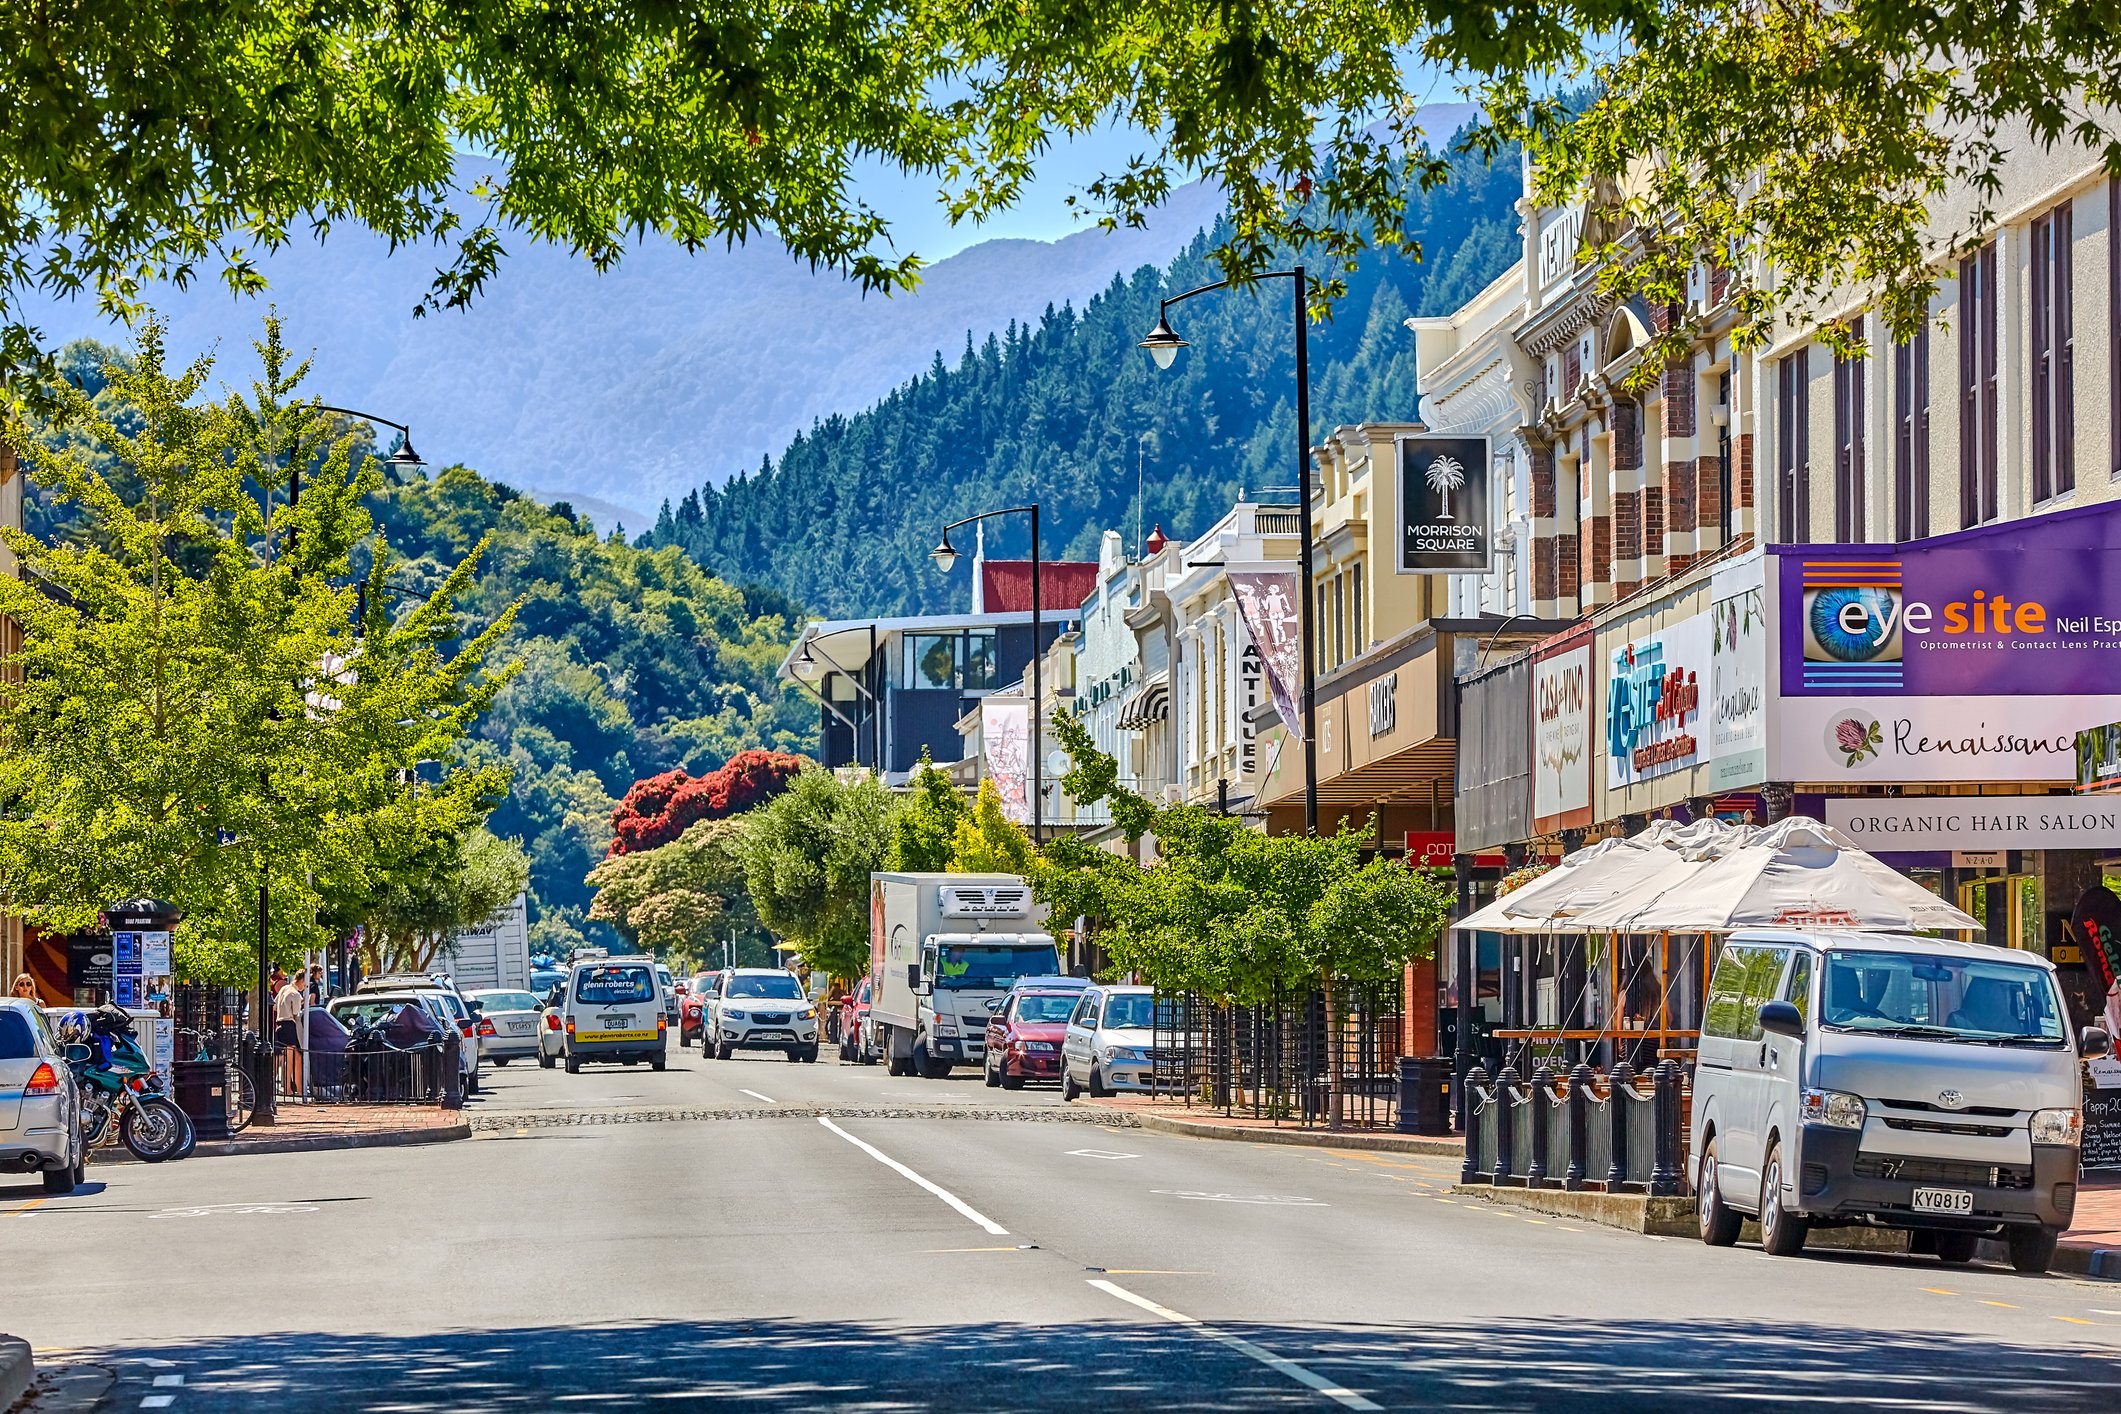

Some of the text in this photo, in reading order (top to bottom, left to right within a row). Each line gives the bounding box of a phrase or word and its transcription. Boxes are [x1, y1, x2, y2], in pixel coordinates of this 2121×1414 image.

[1407, 525, 1482, 536] MORRISON
[1416, 539, 1475, 551] SQUARE
[1839, 602, 1933, 647] eye
[1943, 589, 2046, 634] site
[2056, 617, 2089, 633] Neil
[1920, 640, 1992, 651] Optometrist
[1997, 640, 2004, 649] &
[2011, 640, 2057, 649] Contact
[2062, 640, 2088, 649] Lens
[1540, 673, 1559, 723] CASA
[1563, 664, 1584, 714] VINO
[1715, 666, 1760, 725] Renaissance
[1894, 718, 2077, 756] Renaissanc
[1850, 814, 2116, 833] ORGANIC HAIR SALON
[1785, 915, 1848, 926] STELLA
[2083, 917, 2114, 987] Roma
[583, 980, 635, 990] glenn roberts
[1914, 1191, 1972, 1210] KYQ819
